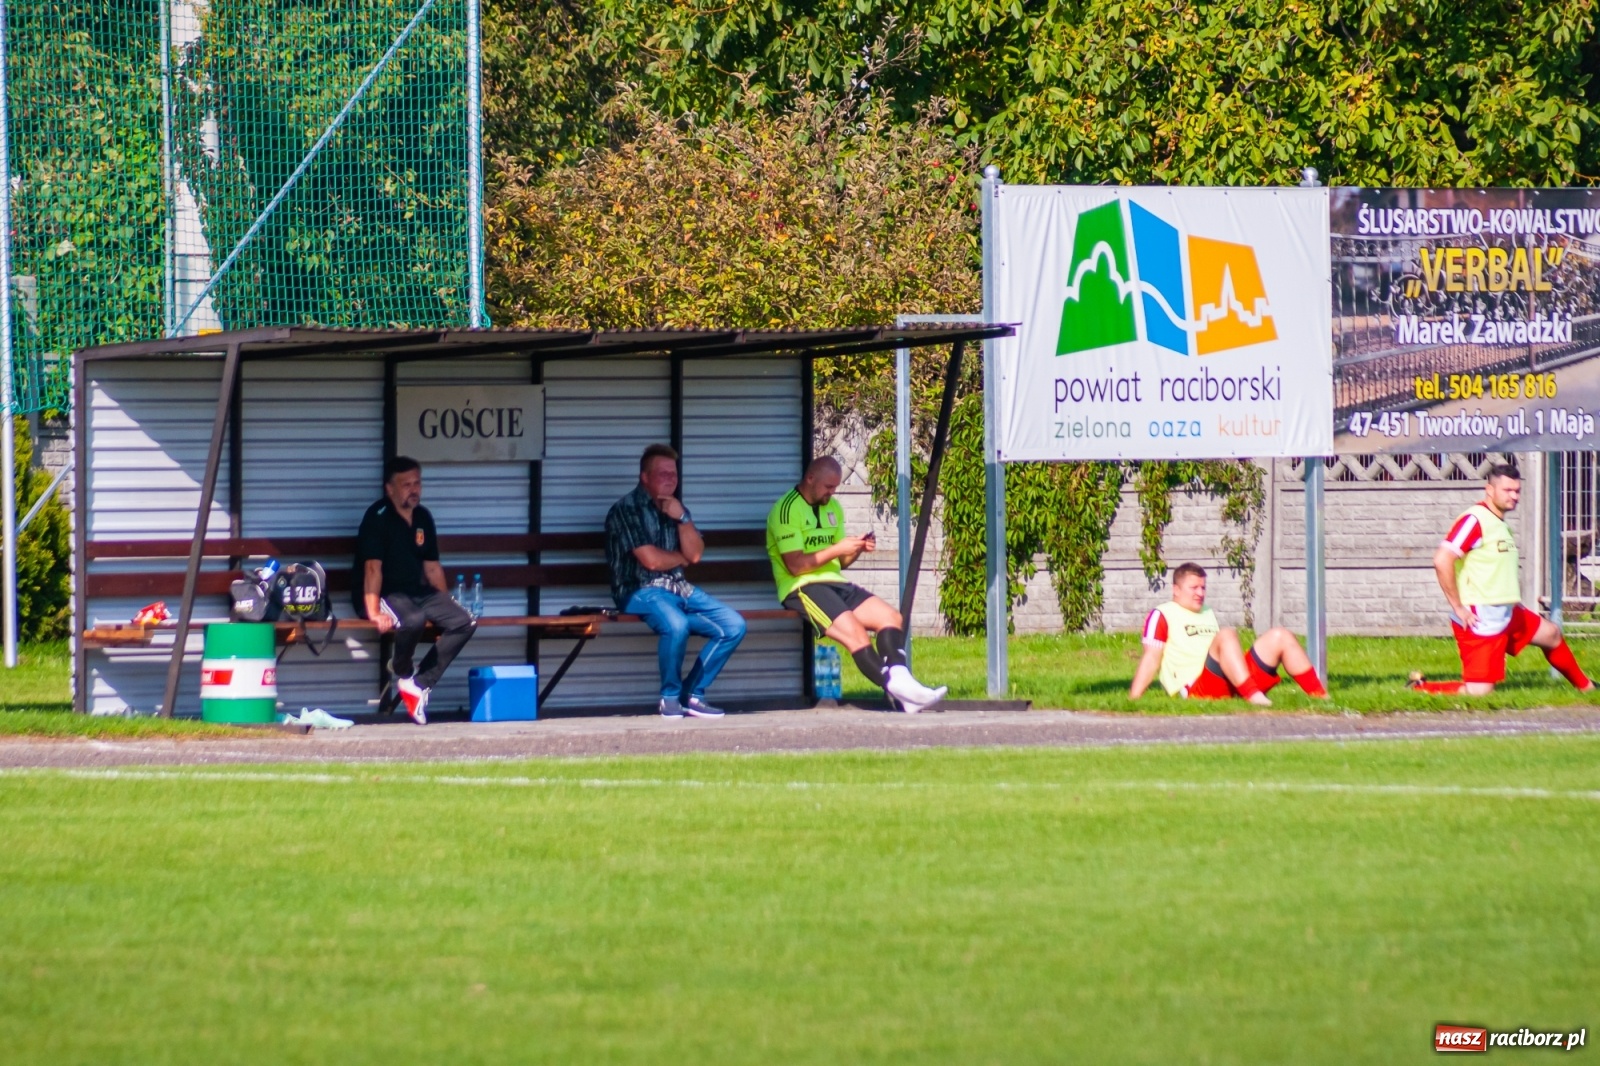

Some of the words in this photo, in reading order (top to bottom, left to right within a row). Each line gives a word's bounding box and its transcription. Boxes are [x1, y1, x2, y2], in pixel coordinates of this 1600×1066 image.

[1398, 314, 1467, 345] Marek
[1471, 312, 1573, 344] Zawadzki
[1054, 367, 1142, 413] powiat
[1160, 366, 1281, 401] raciborski
[1415, 373, 1445, 400] tel.
[1449, 374, 1484, 399] 504
[1489, 374, 1520, 399] 165
[1524, 373, 1557, 399] 816
[418, 399, 524, 439] GOŚCIE
[1054, 416, 1131, 438] zielona
[1149, 420, 1201, 437] oaza
[1218, 414, 1281, 436] kultur
[1350, 411, 1410, 437] 47-451
[1416, 408, 1503, 439] Tworków,
[1507, 409, 1531, 436] ul.
[1535, 409, 1544, 435] 1
[1550, 407, 1595, 441] Maja
